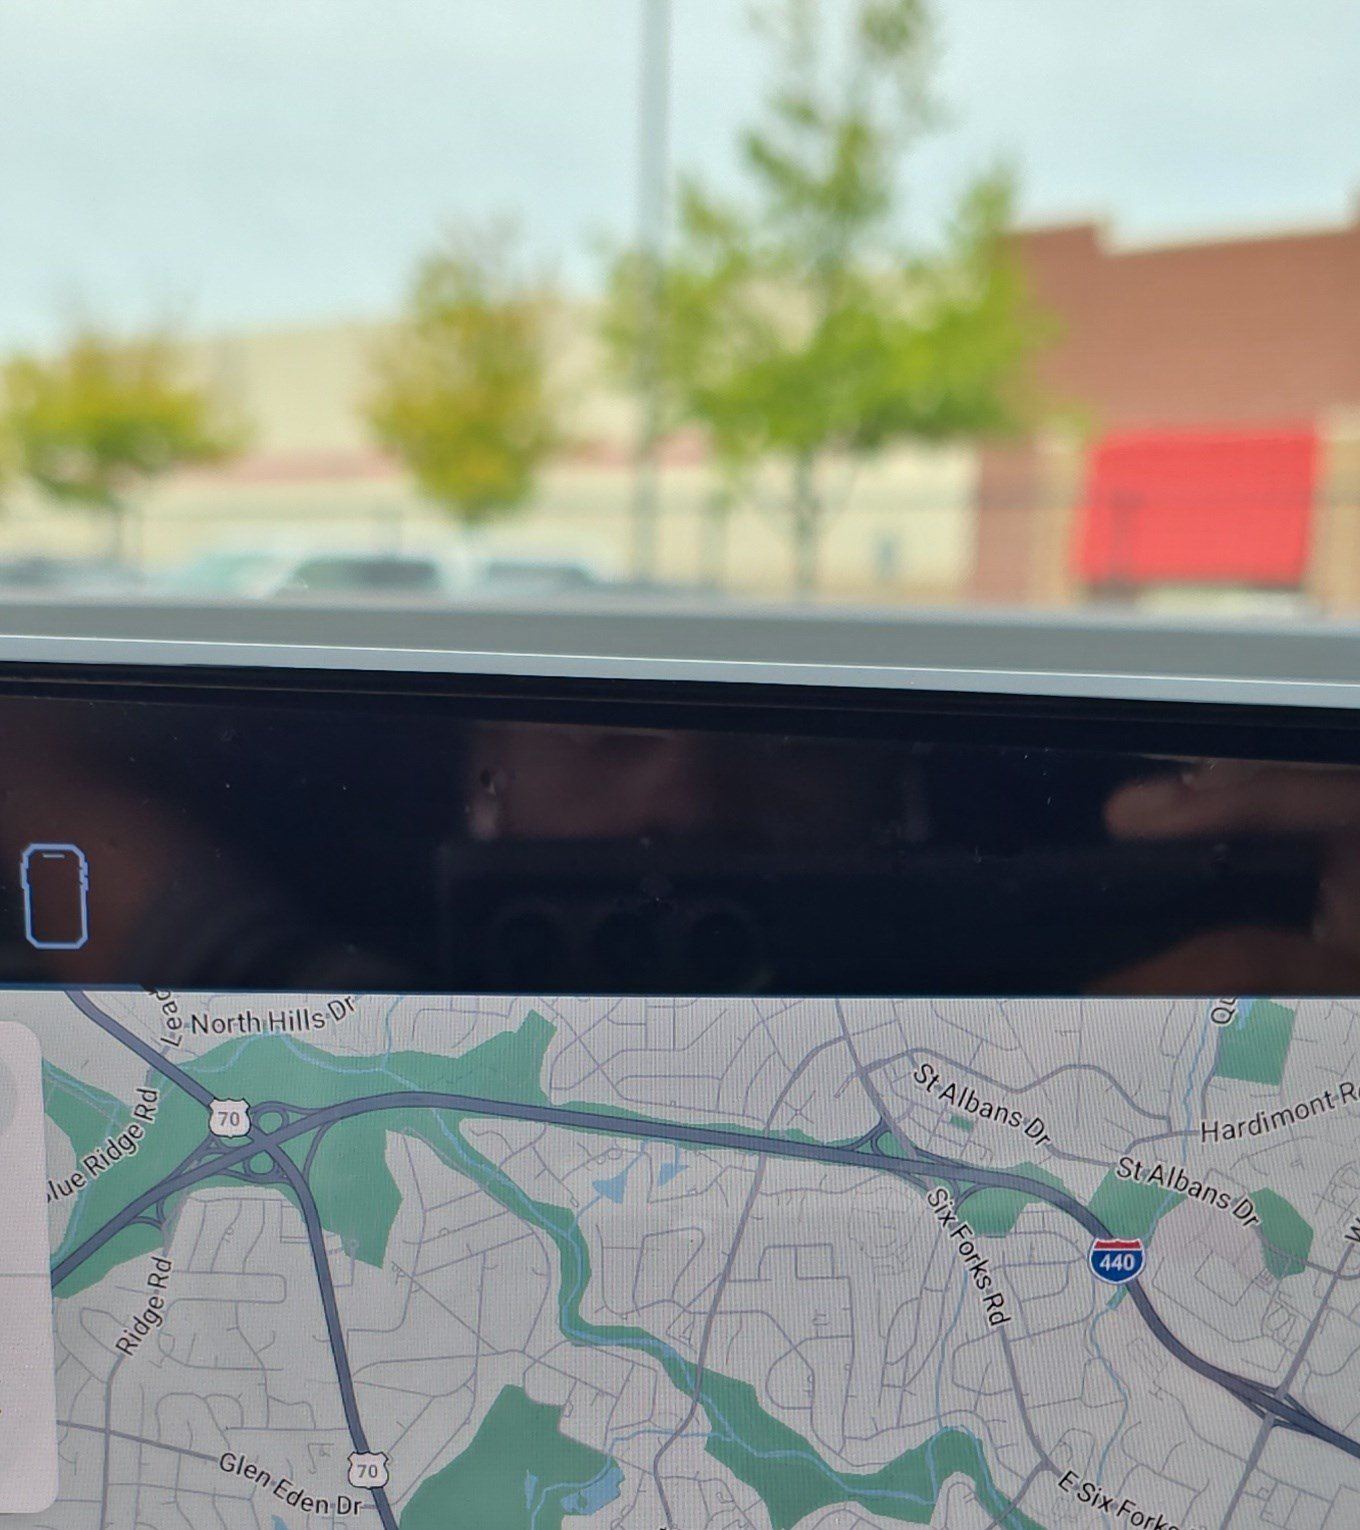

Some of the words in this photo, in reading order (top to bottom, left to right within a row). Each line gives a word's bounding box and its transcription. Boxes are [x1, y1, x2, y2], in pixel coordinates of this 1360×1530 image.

[192, 1011, 260, 1034] North
[269, 1008, 325, 1032] Hills
[328, 996, 355, 1021] Dr
[218, 1111, 240, 1127] 70
[912, 1063, 938, 1092] St
[938, 1081, 1022, 1131] Albans
[1024, 1114, 1051, 1149] Dr
[1200, 1094, 1334, 1142] Hardimont
[48, 1173, 86, 1203] lue
[83, 1124, 144, 1176] Ridge
[134, 1088, 157, 1121] Rd
[1116, 1158, 1145, 1181] St
[1147, 1164, 1229, 1209] Albans
[1231, 1199, 1260, 1229] Dr
[926, 1186, 956, 1225] Six
[950, 1224, 992, 1290] Forks
[981, 1291, 1010, 1327] Rd
[1099, 1253, 1135, 1272] 440
[115, 1292, 166, 1356] Ridge
[147, 1255, 172, 1290] Rd
[218, 1452, 274, 1491] Glen
[273, 1478, 330, 1514] Eden
[337, 1496, 362, 1516] Dr
[357, 1464, 378, 1479] 70
[1059, 1471, 1076, 1492] E
[1076, 1480, 1118, 1518] Six
